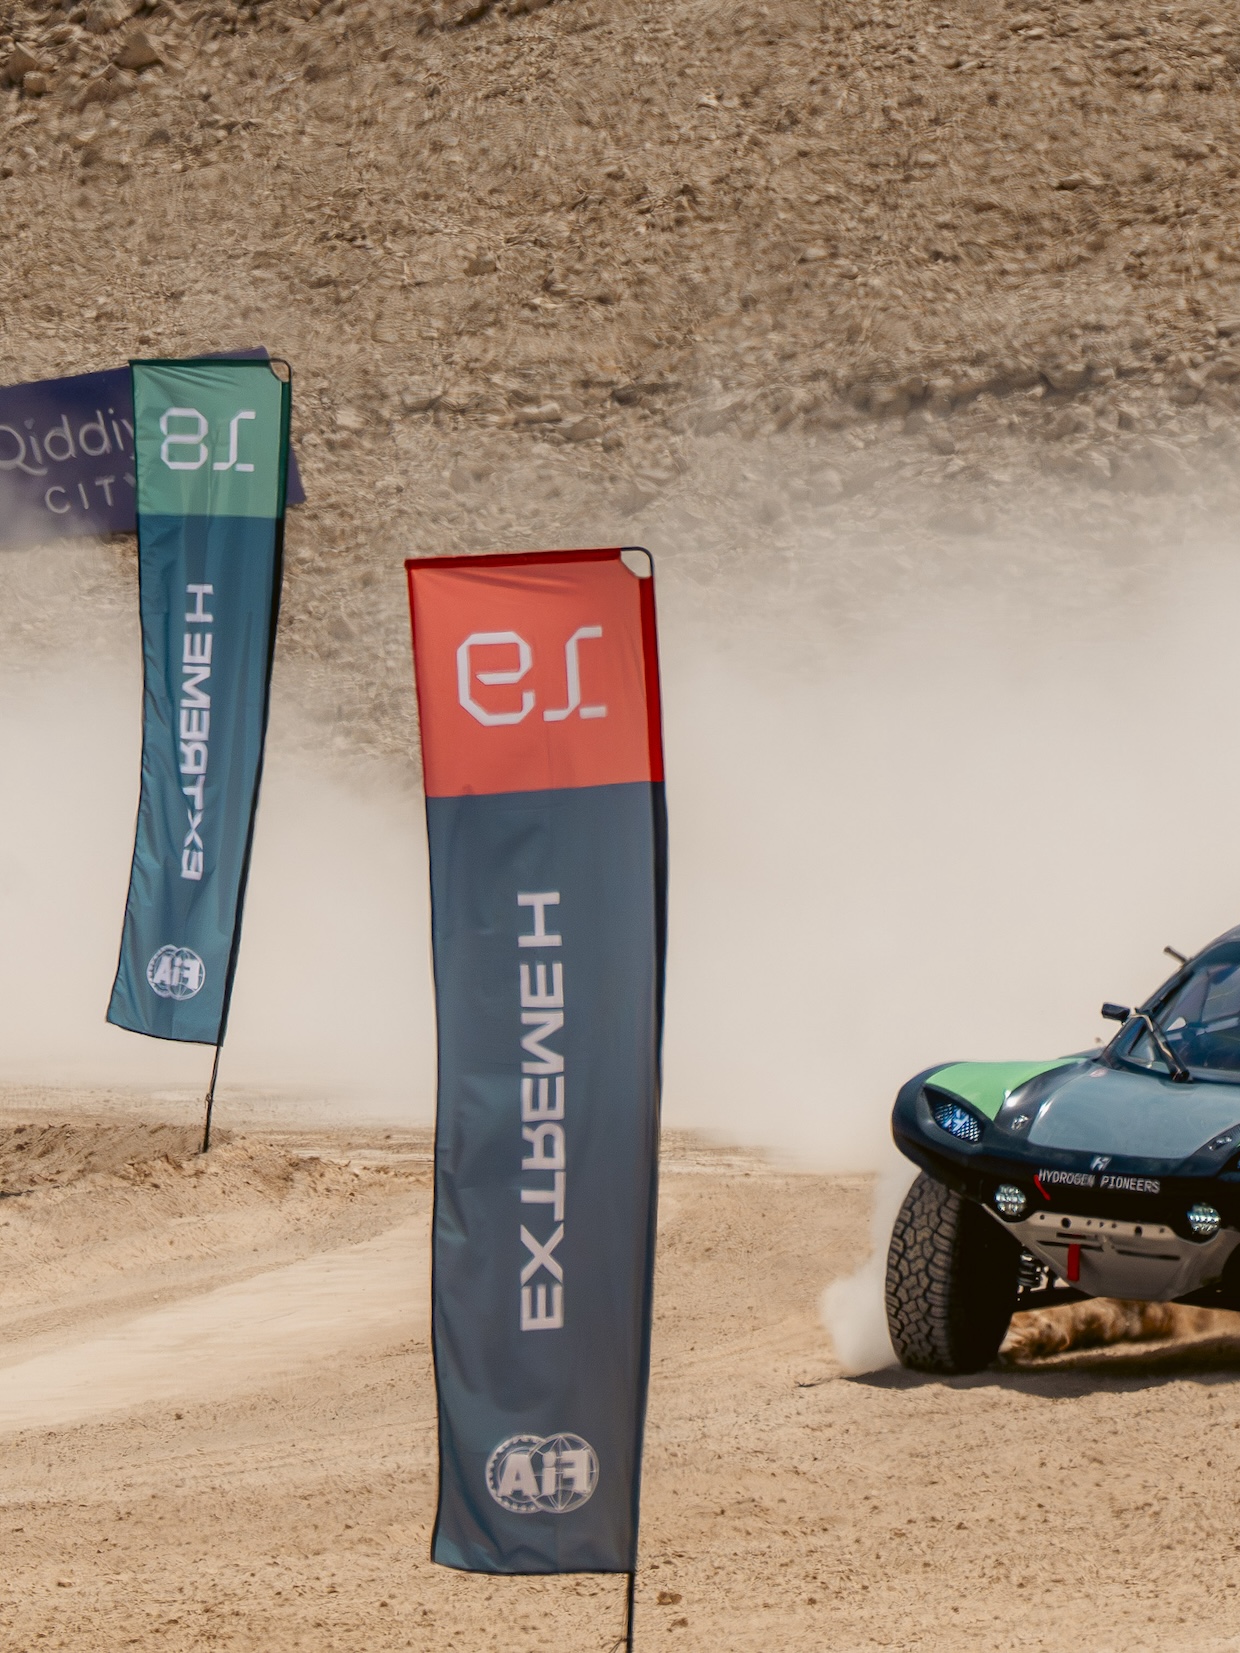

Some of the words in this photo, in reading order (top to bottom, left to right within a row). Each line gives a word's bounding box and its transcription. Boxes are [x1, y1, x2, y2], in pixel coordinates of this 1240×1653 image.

[45, 472, 137, 514] CIT
[1038, 1168, 1096, 1188] HYDROGEN
[1100, 1175, 1160, 1194] PIONEERS
